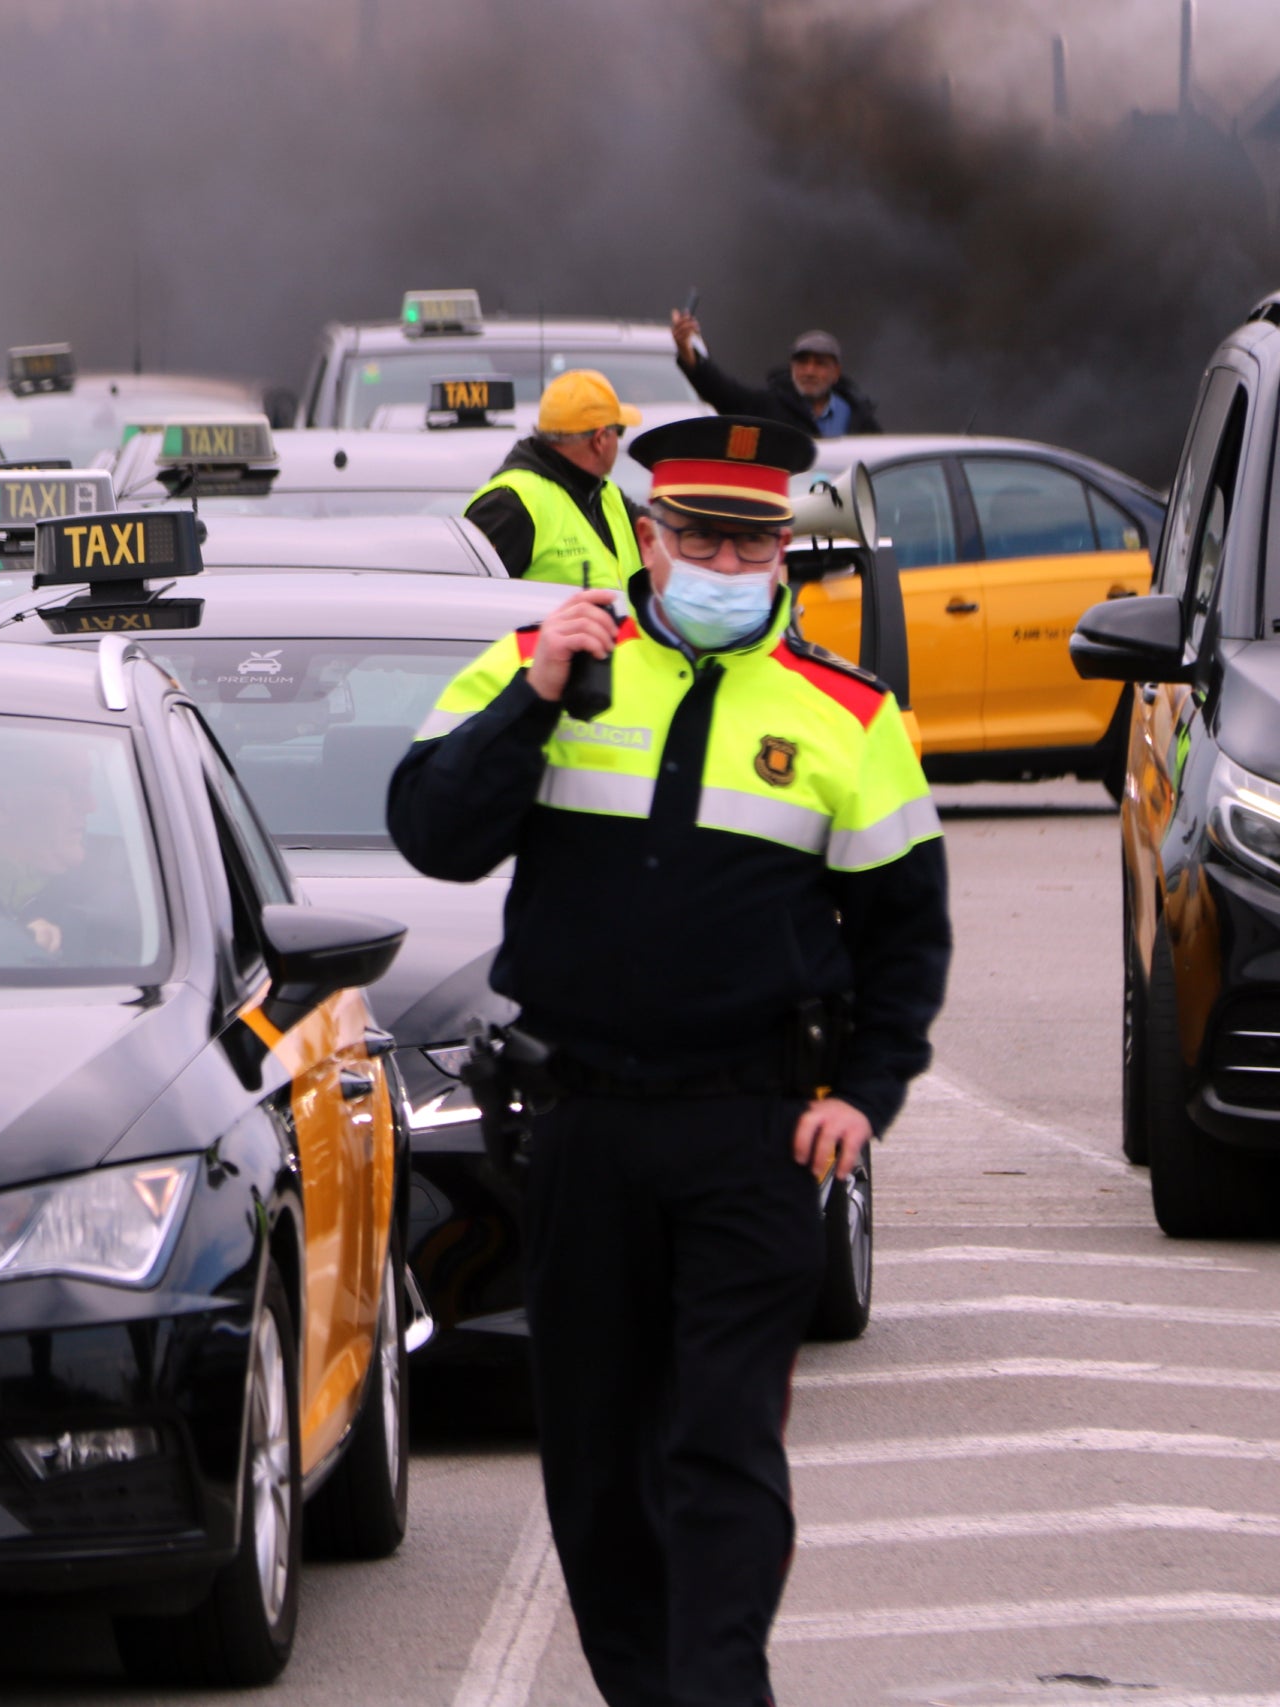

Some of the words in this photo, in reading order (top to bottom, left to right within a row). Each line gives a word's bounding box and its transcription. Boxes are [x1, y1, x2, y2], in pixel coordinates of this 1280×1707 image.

[443, 381, 489, 409] TAXI
[187, 426, 235, 457] TAXI
[4, 482, 67, 518] TAXI
[63, 522, 146, 569] TAXI
[216, 675, 294, 684] PREMIUM
